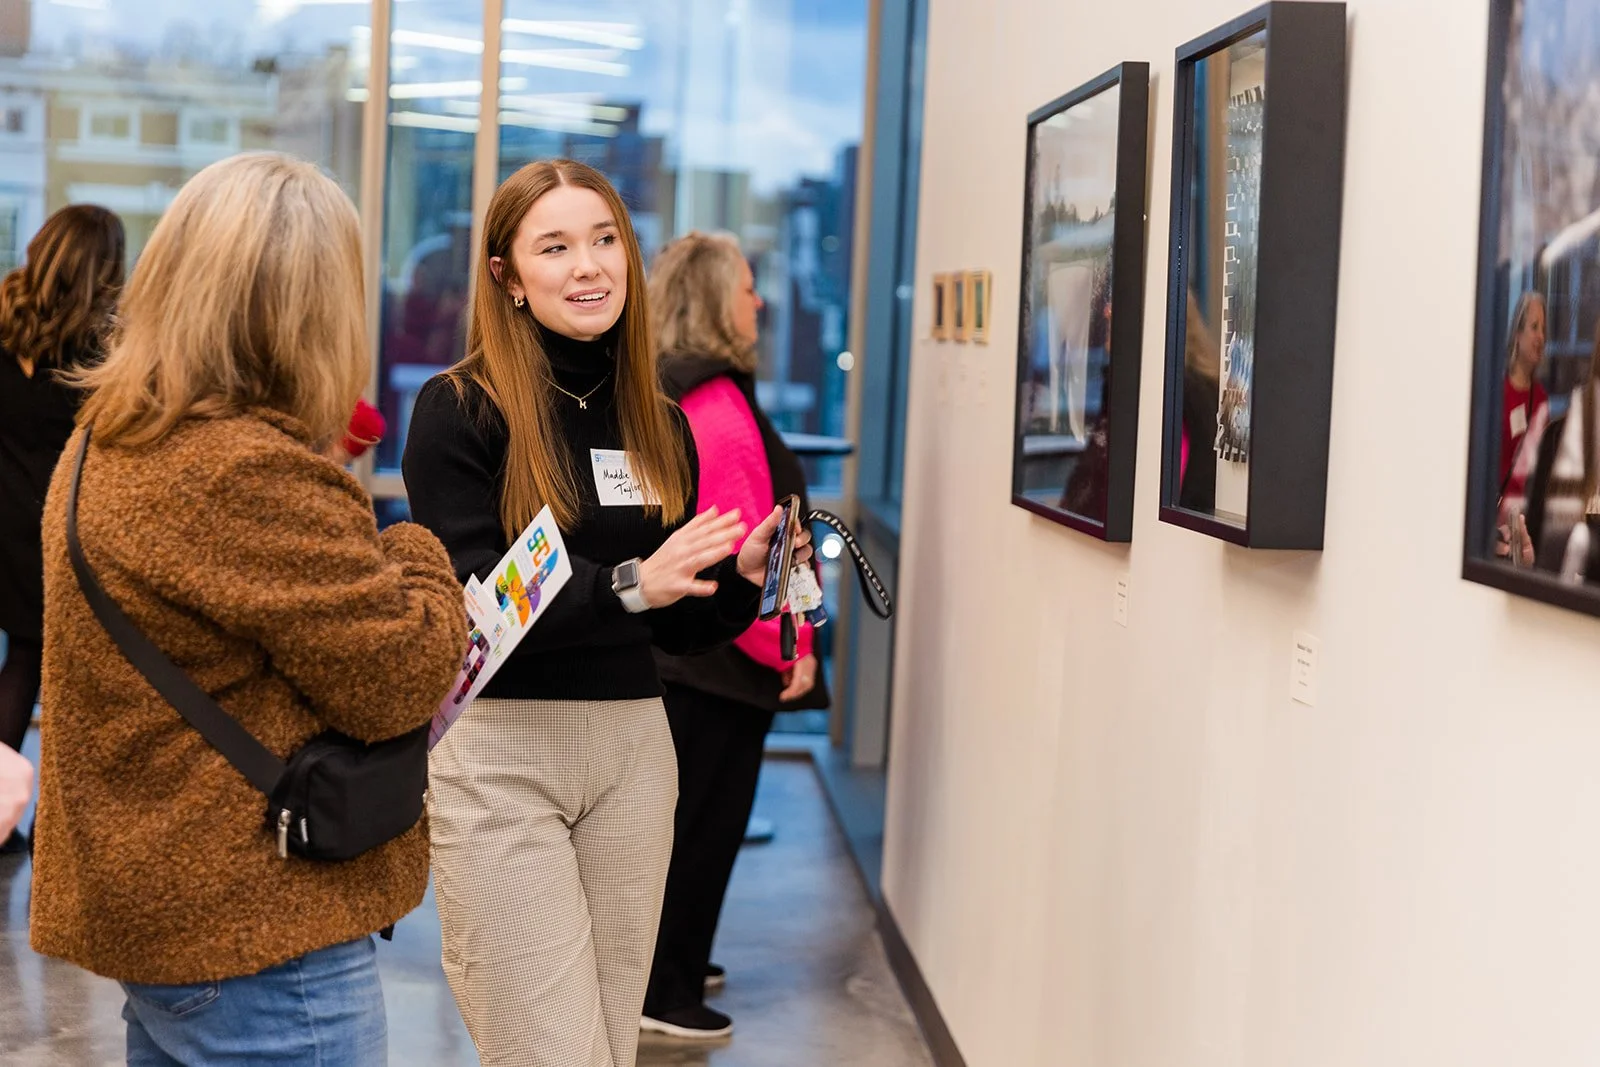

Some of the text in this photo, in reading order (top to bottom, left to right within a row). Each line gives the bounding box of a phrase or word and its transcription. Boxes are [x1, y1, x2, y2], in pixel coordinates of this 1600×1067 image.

[603, 469, 630, 480] Maddie
[614, 481, 641, 499] Taylor
[809, 510, 890, 606] lululemon
